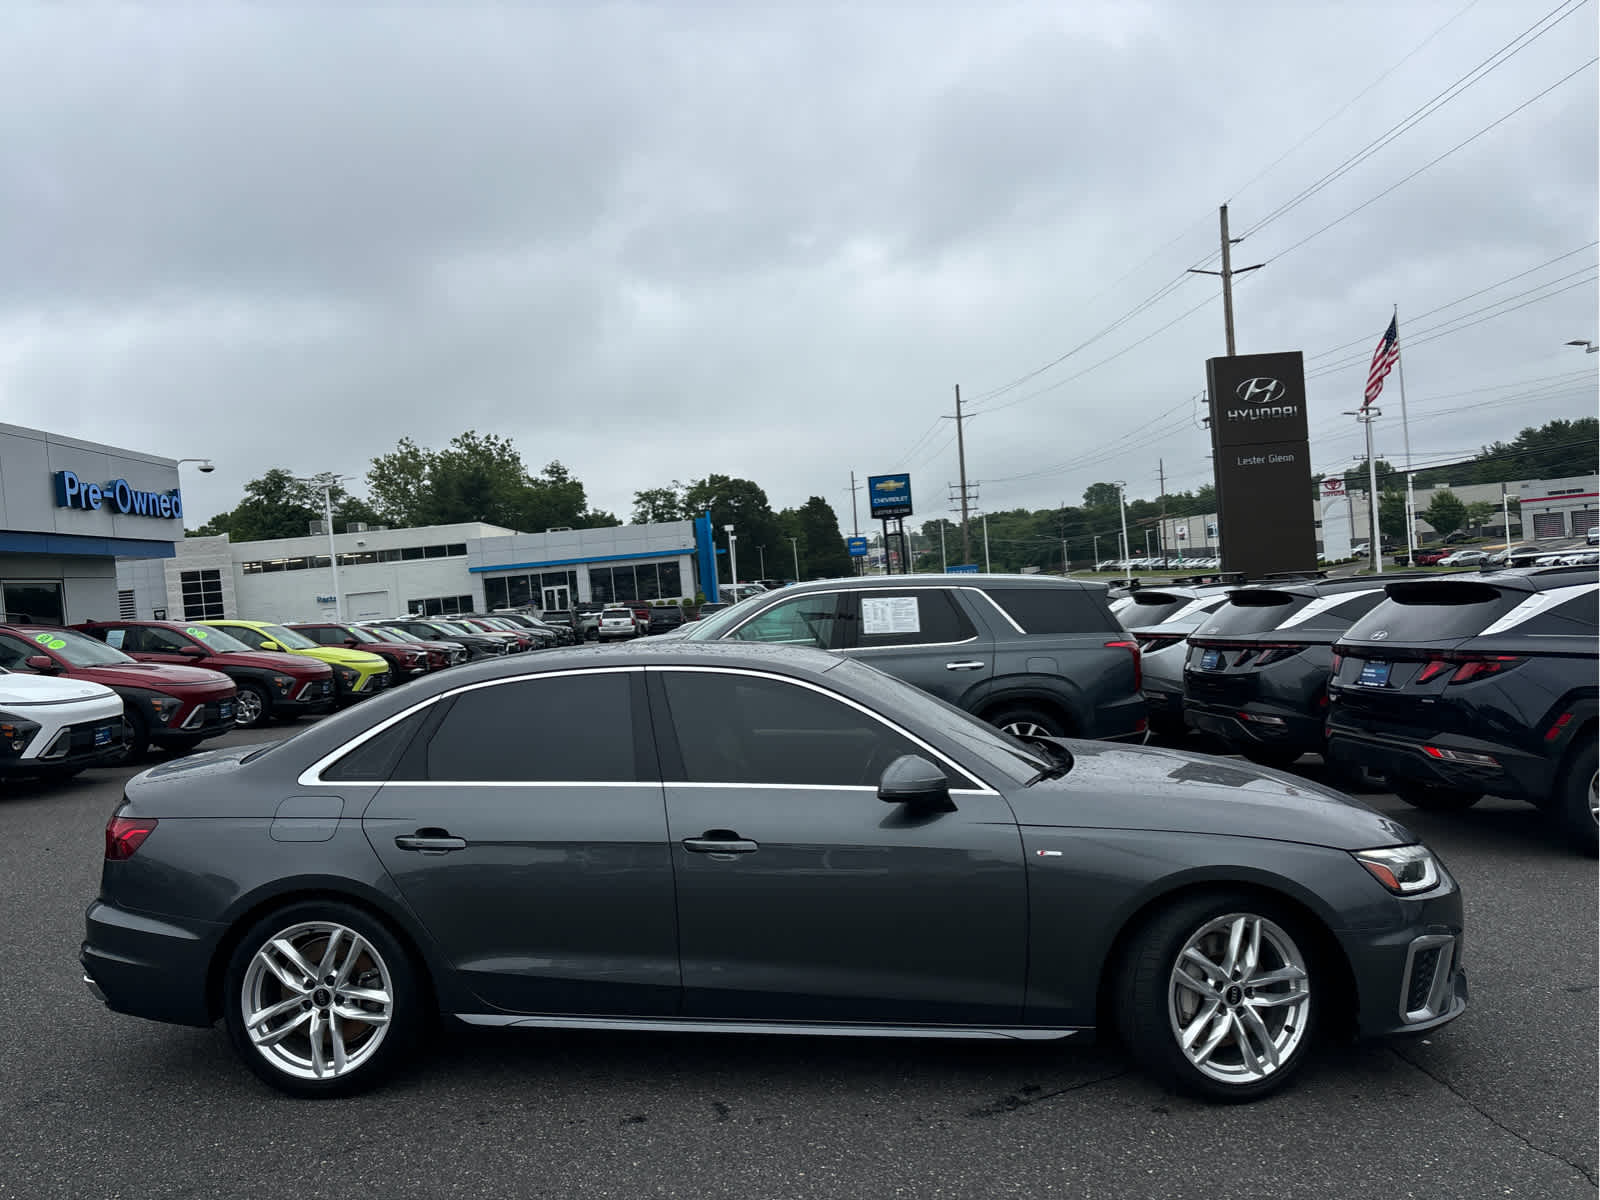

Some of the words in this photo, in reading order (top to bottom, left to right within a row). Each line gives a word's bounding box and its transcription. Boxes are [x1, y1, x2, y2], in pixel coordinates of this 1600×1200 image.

[1227, 405, 1297, 420] HYUNDAI
[1237, 456, 1265, 466] Lester
[1268, 454, 1295, 464] Glenn
[56, 470, 182, 519] Pre-Owned
[873, 496, 908, 504] CHEVROLET
